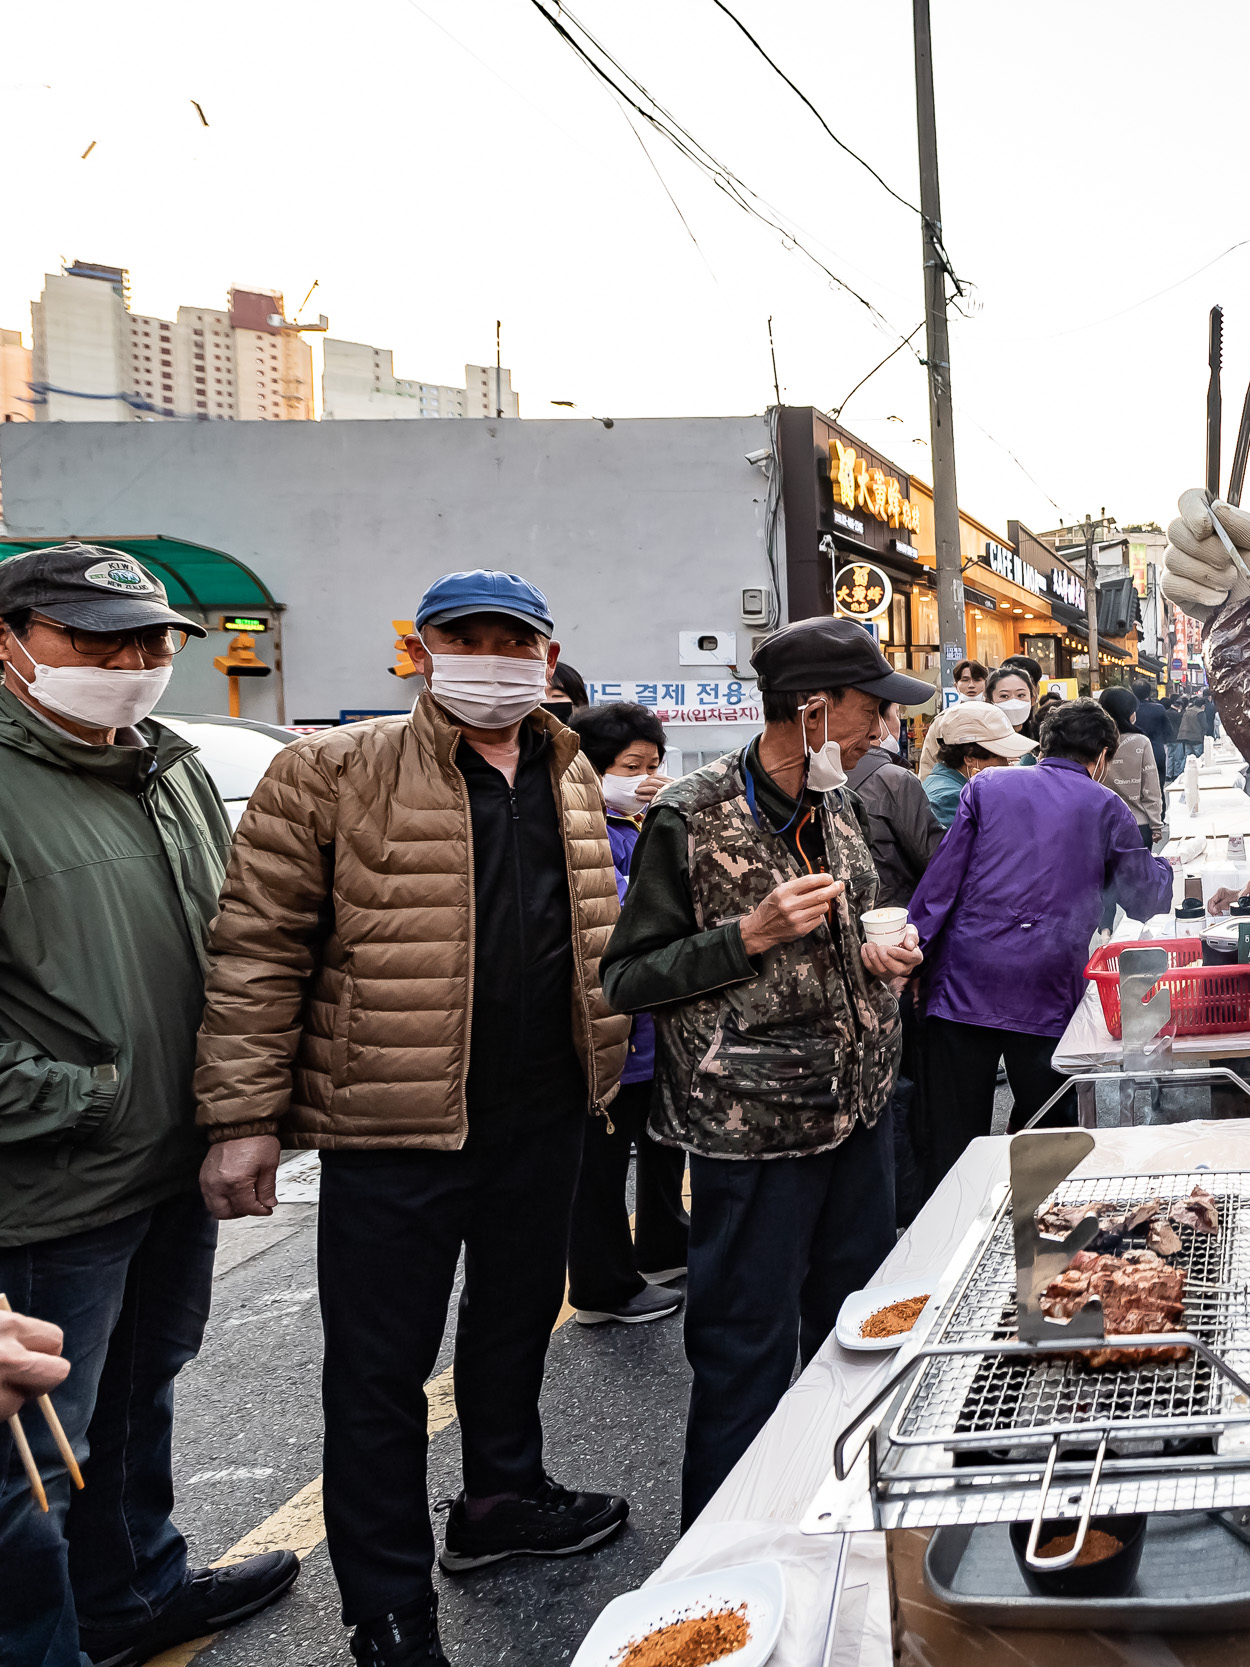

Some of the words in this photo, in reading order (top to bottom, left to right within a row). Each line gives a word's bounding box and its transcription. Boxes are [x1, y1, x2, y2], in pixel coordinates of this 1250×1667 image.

[107, 562, 135, 572] KIWI
[989, 539, 1013, 582] CAFE
[107, 580, 123, 589] NEW
[635, 682, 686, 707] 결제
[696, 681, 747, 706] 전용
